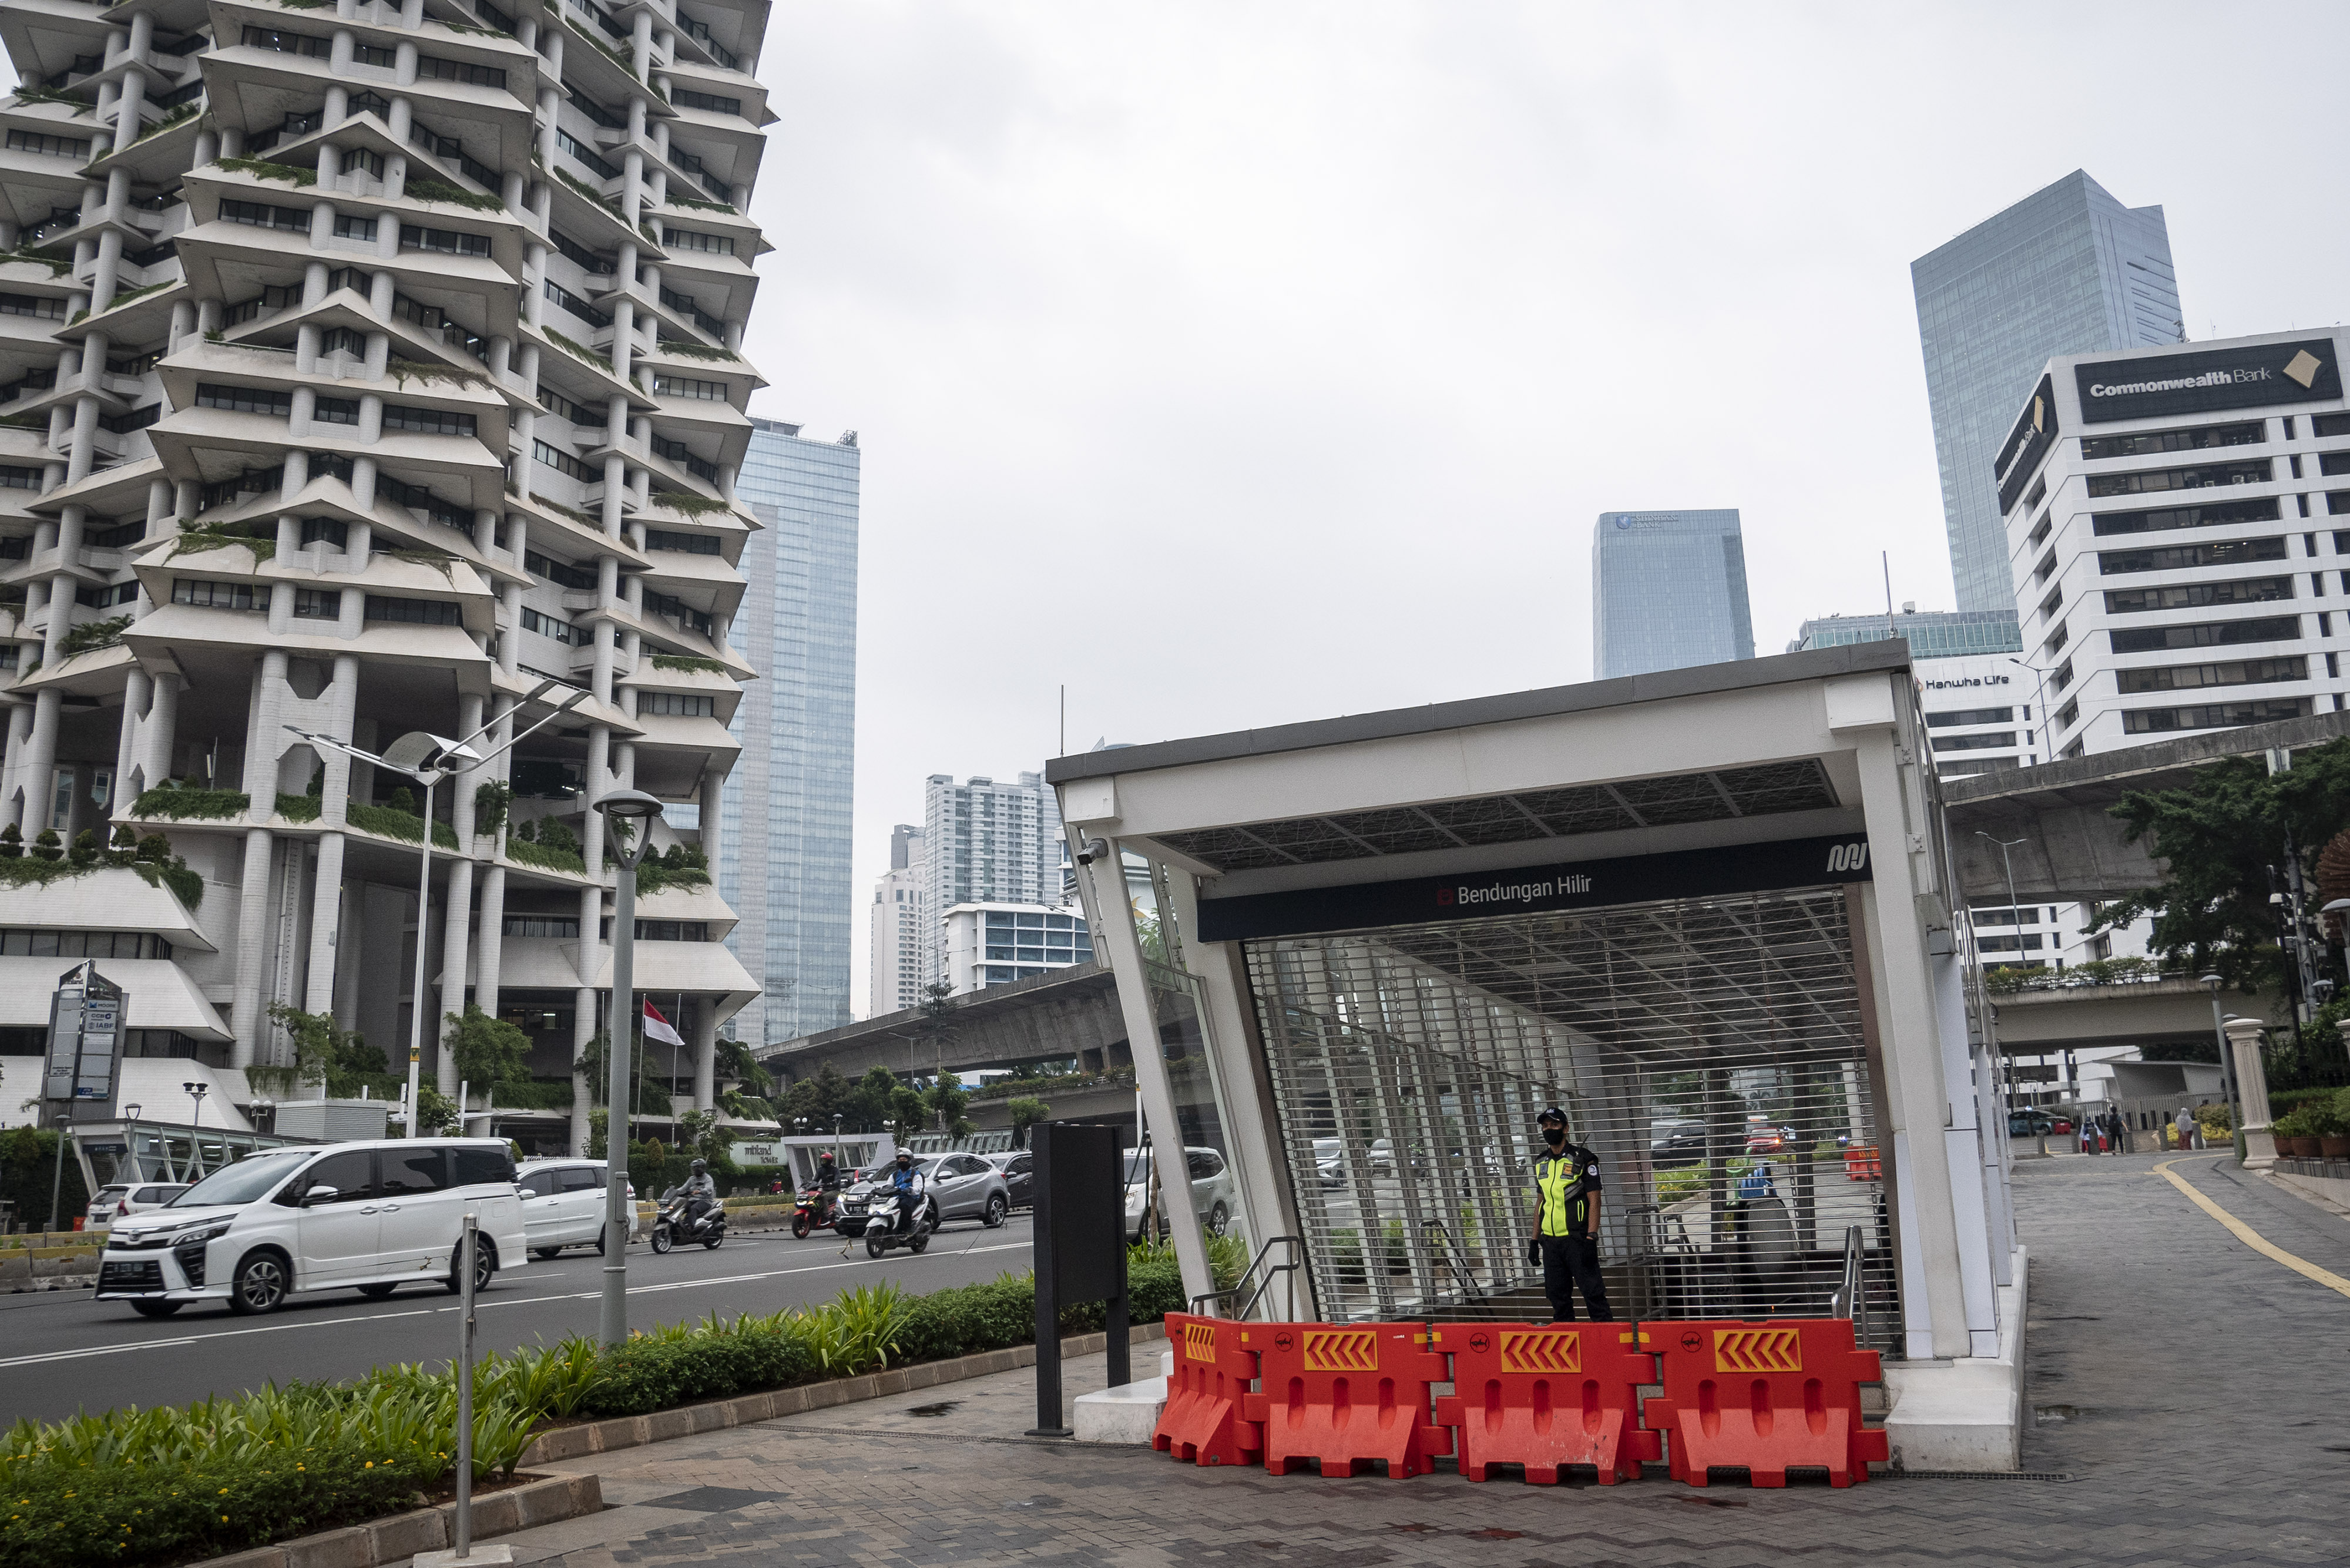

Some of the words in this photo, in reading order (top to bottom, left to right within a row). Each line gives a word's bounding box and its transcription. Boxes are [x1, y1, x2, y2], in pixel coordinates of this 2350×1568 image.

[2090, 371, 2232, 398] Commonwealth
[2232, 367, 2272, 384] Bank
[1926, 677, 1981, 690] Hanwha
[1984, 676, 2009, 686] Life
[1458, 882, 1553, 905] Bendungan
[1557, 874, 1592, 895] Hilir
